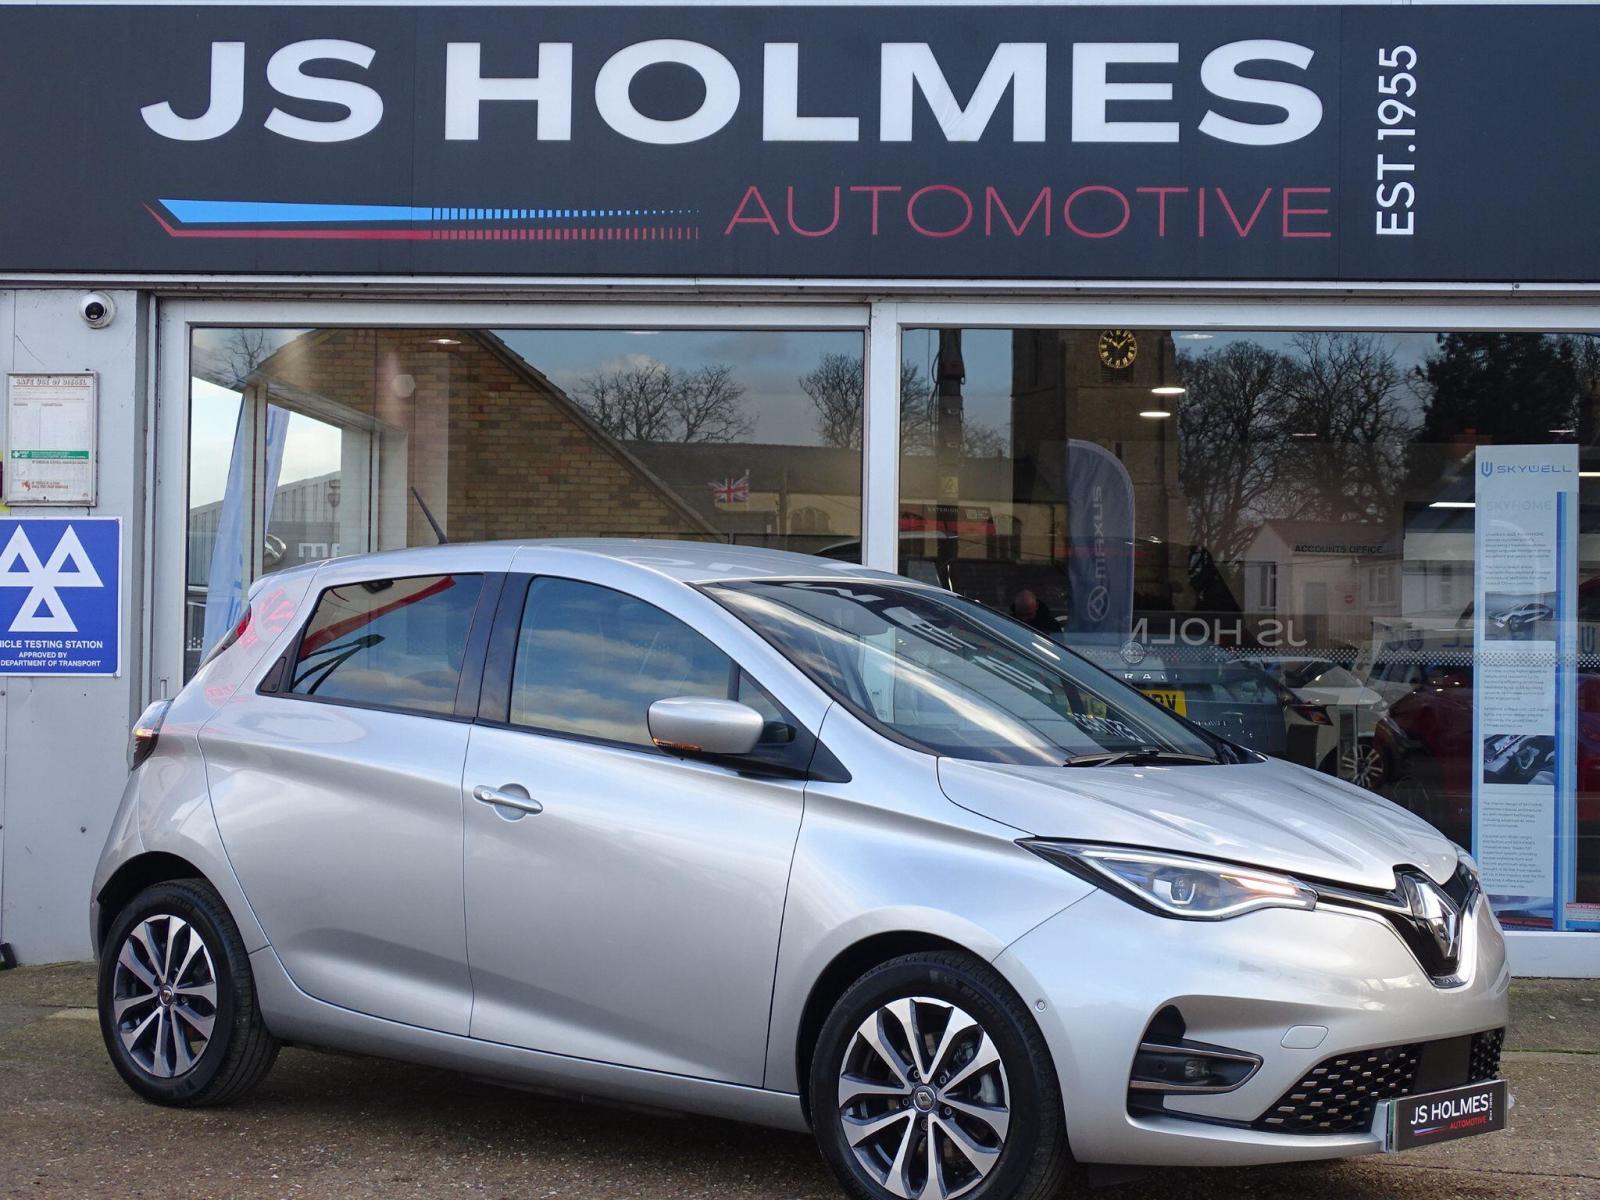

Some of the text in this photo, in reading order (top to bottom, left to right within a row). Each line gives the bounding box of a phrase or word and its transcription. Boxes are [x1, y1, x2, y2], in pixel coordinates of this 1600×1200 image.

[141, 39, 1322, 145] JS HOLMES
[1375, 45, 1418, 236] EST.1955
[725, 184, 1333, 240] AUTOMOTIVE
[1497, 465, 1573, 473] SKYWELL
[1295, 545, 1347, 553] ACCOUNTS
[24, 640, 63, 649] TESTING
[65, 640, 103, 649] STATION
[19, 651, 68, 659] APPROVED BY
[60, 660, 101, 668] TRANSPORT
[1410, 1105, 1428, 1125] JS
[1431, 1094, 1489, 1121] HOLMES
[1449, 1116, 1488, 1130] AUTOMOTIVE
